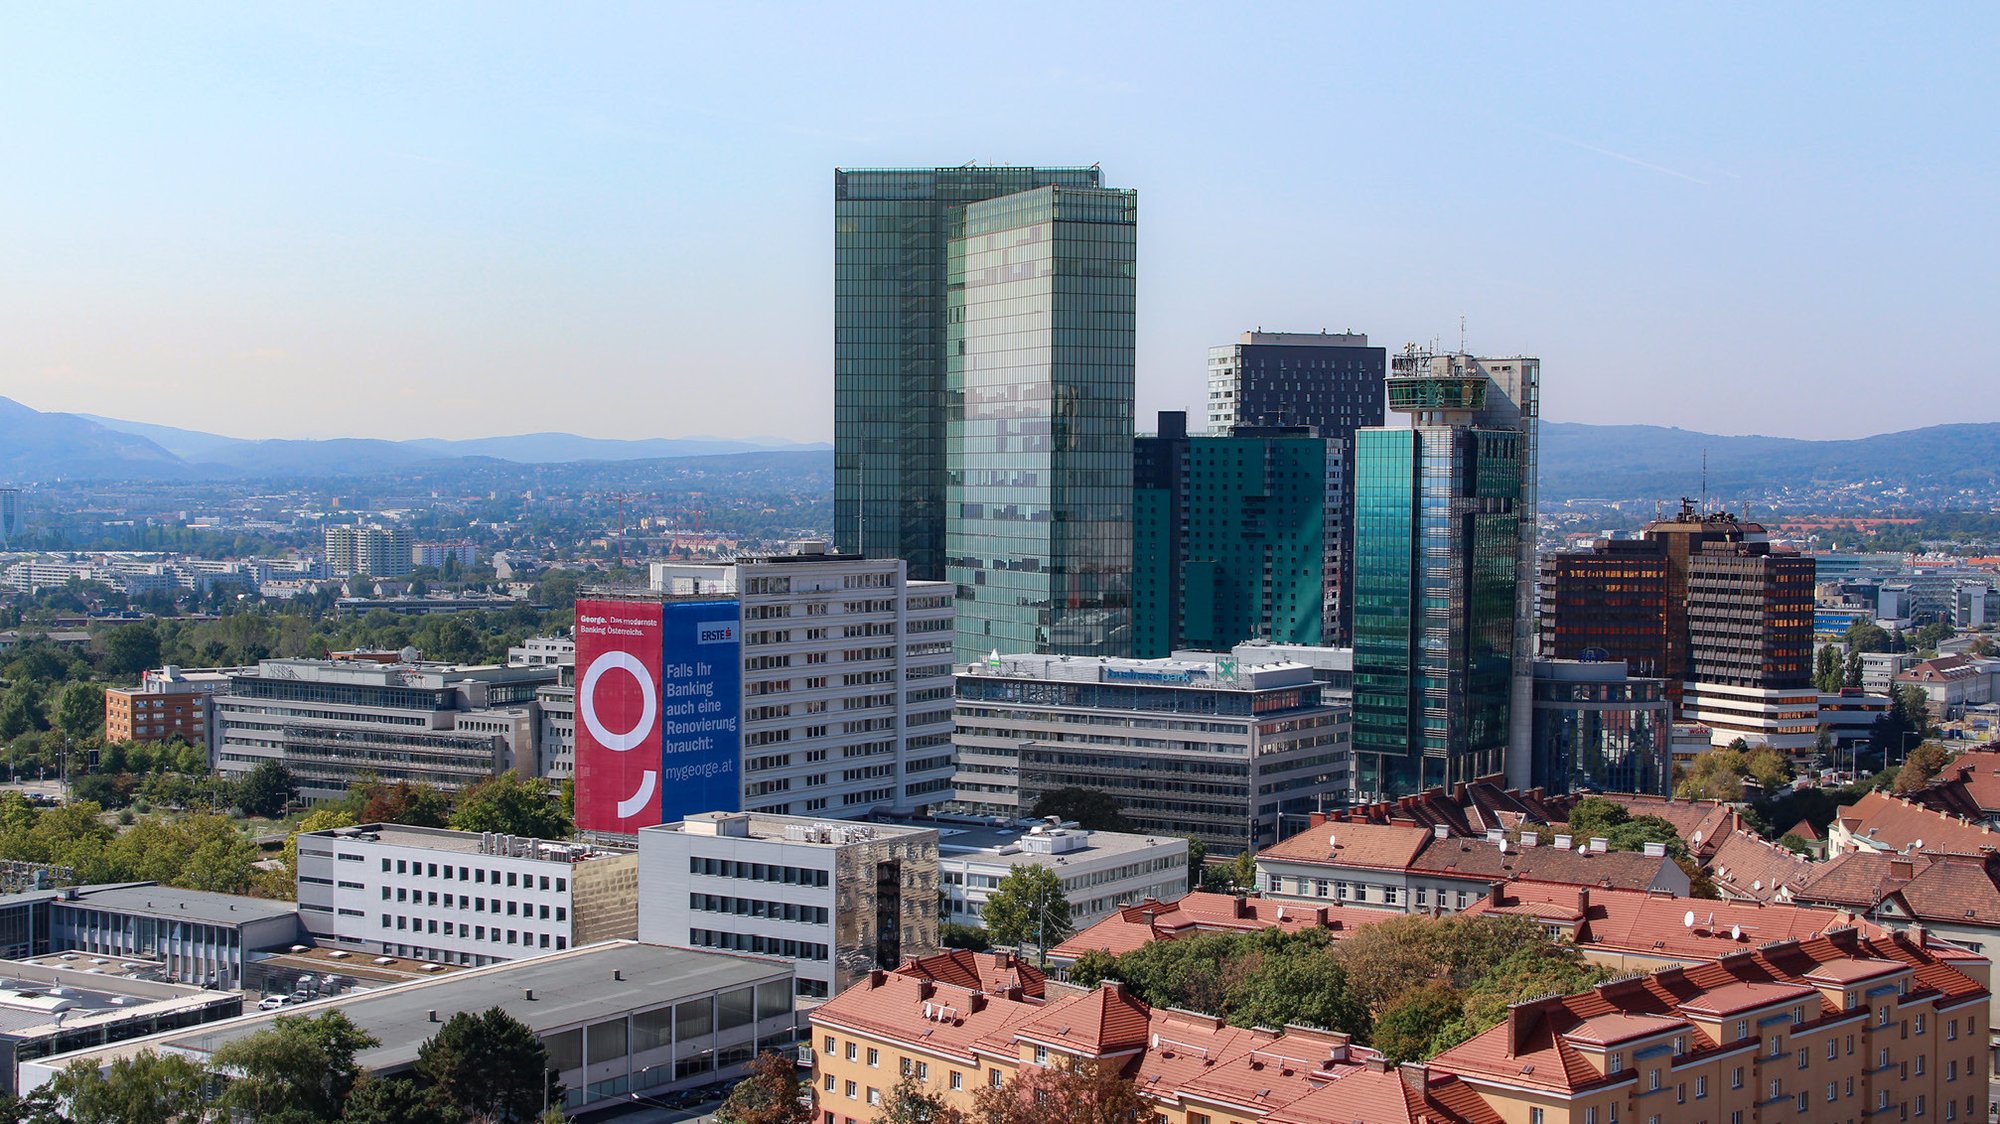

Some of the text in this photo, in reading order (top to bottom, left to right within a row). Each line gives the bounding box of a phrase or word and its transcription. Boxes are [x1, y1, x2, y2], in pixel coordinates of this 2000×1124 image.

[580, 615, 658, 627] George. Das modernste
[580, 625, 606, 635] Banking
[702, 630, 725, 641] ERSTE
[667, 661, 712, 679] Falls Ihr
[667, 681, 714, 697] Banking
[666, 699, 722, 717] auch eine
[667, 716, 737, 735] Renovierung
[666, 736, 714, 754] braucht:
[665, 758, 733, 781] mygeorge.at
